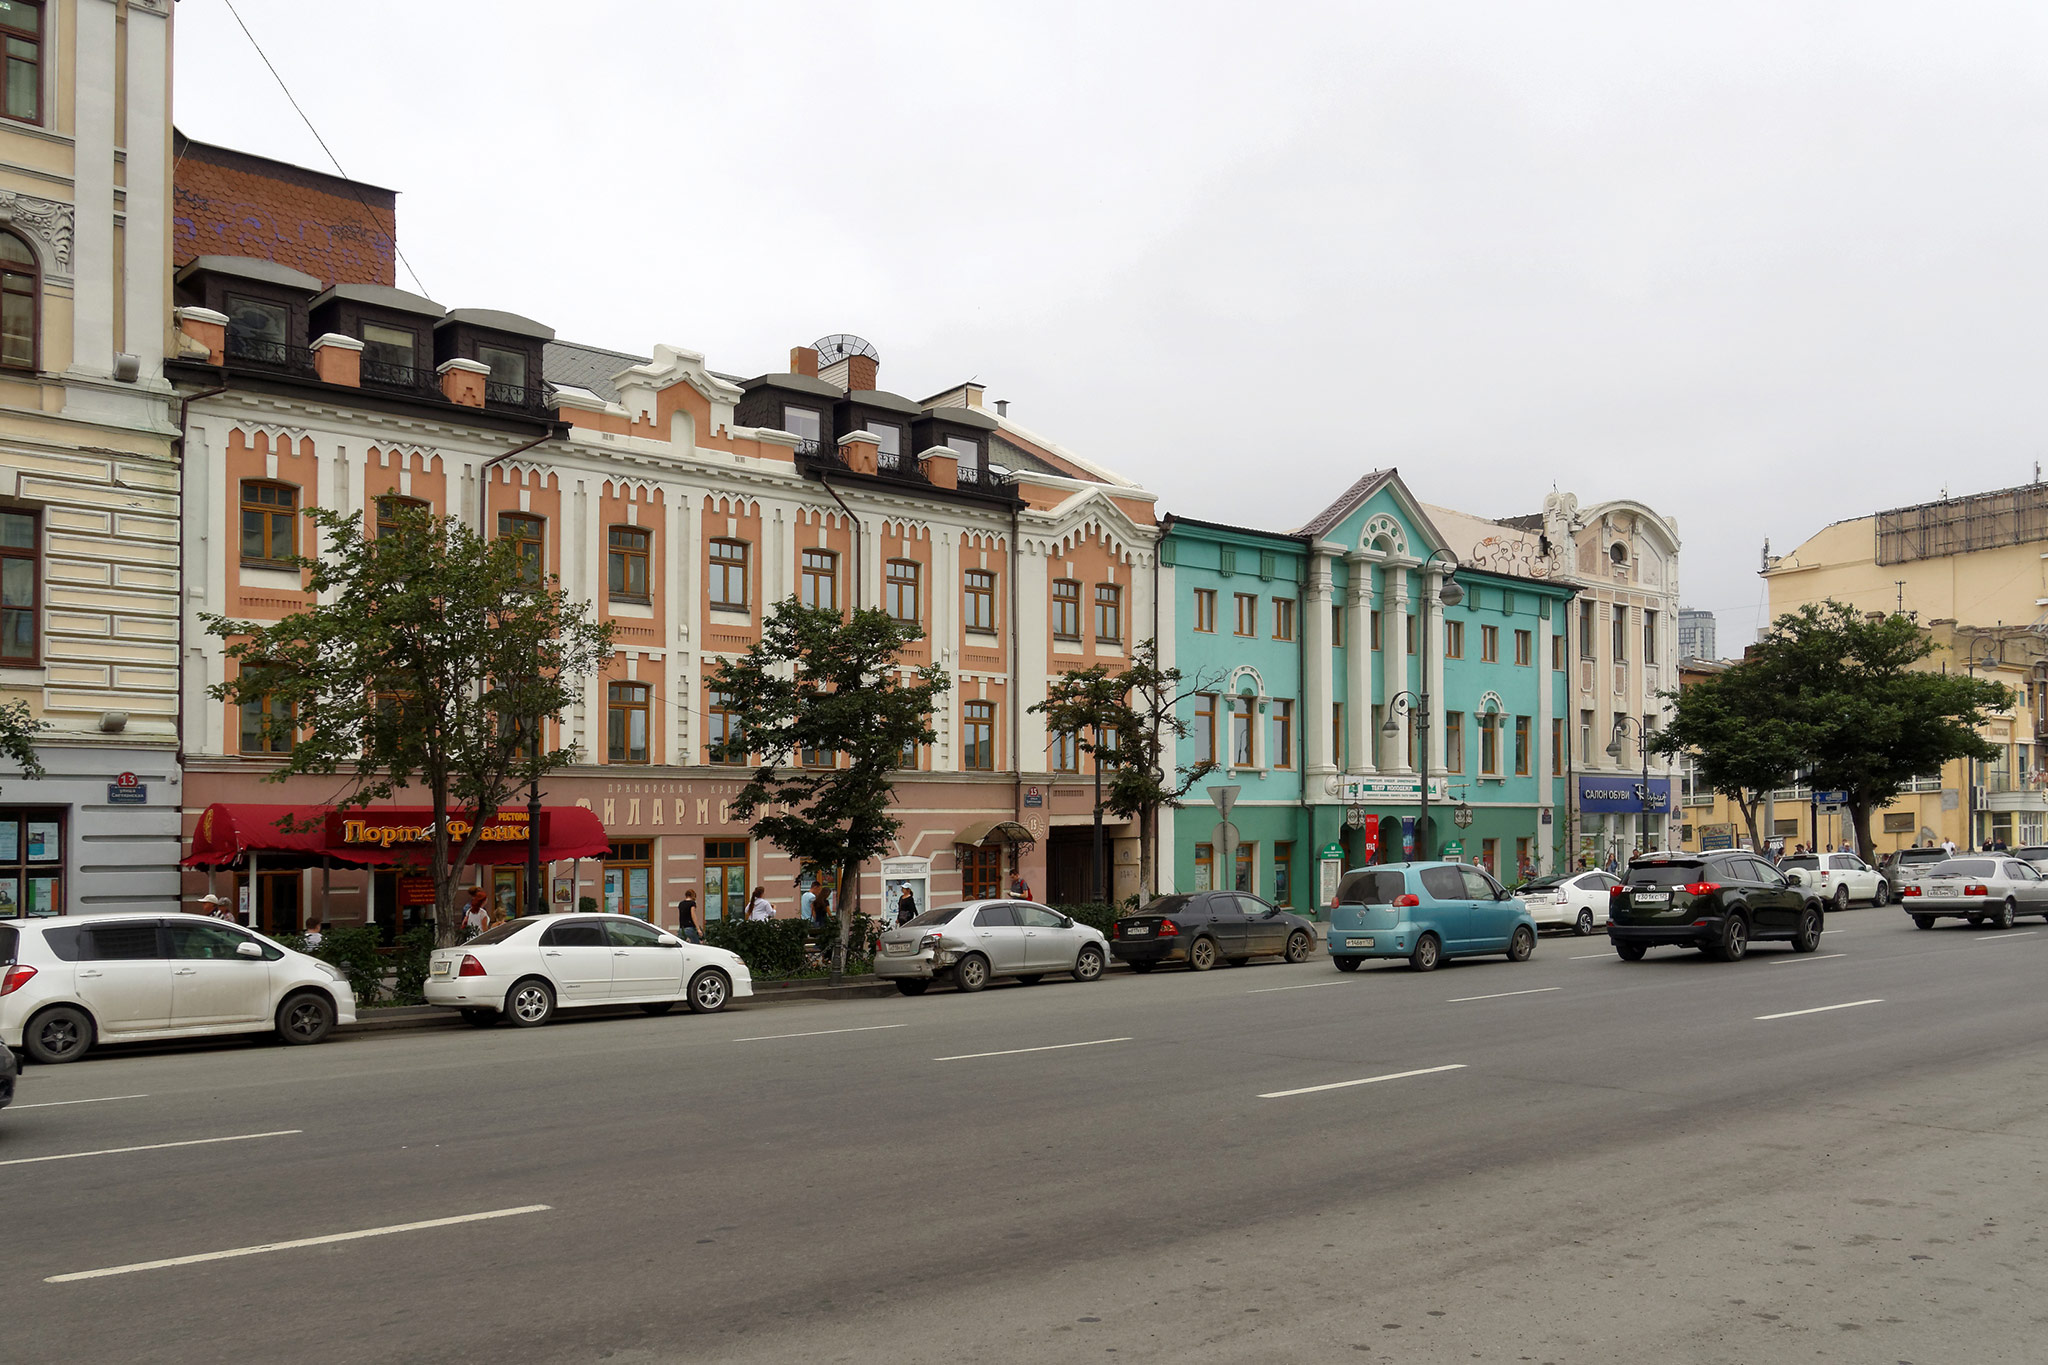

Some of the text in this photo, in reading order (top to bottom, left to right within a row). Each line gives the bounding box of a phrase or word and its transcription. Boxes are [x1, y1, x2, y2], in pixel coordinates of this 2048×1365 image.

[120, 775, 135, 786] 13
[608, 784, 693, 794] ПРИМОРСКАЯ
[1030, 788, 1037, 796] 15
[1585, 789, 1630, 800] САЛОН ОБУВИ
[575, 798, 791, 826] ИЛАРМОИ
